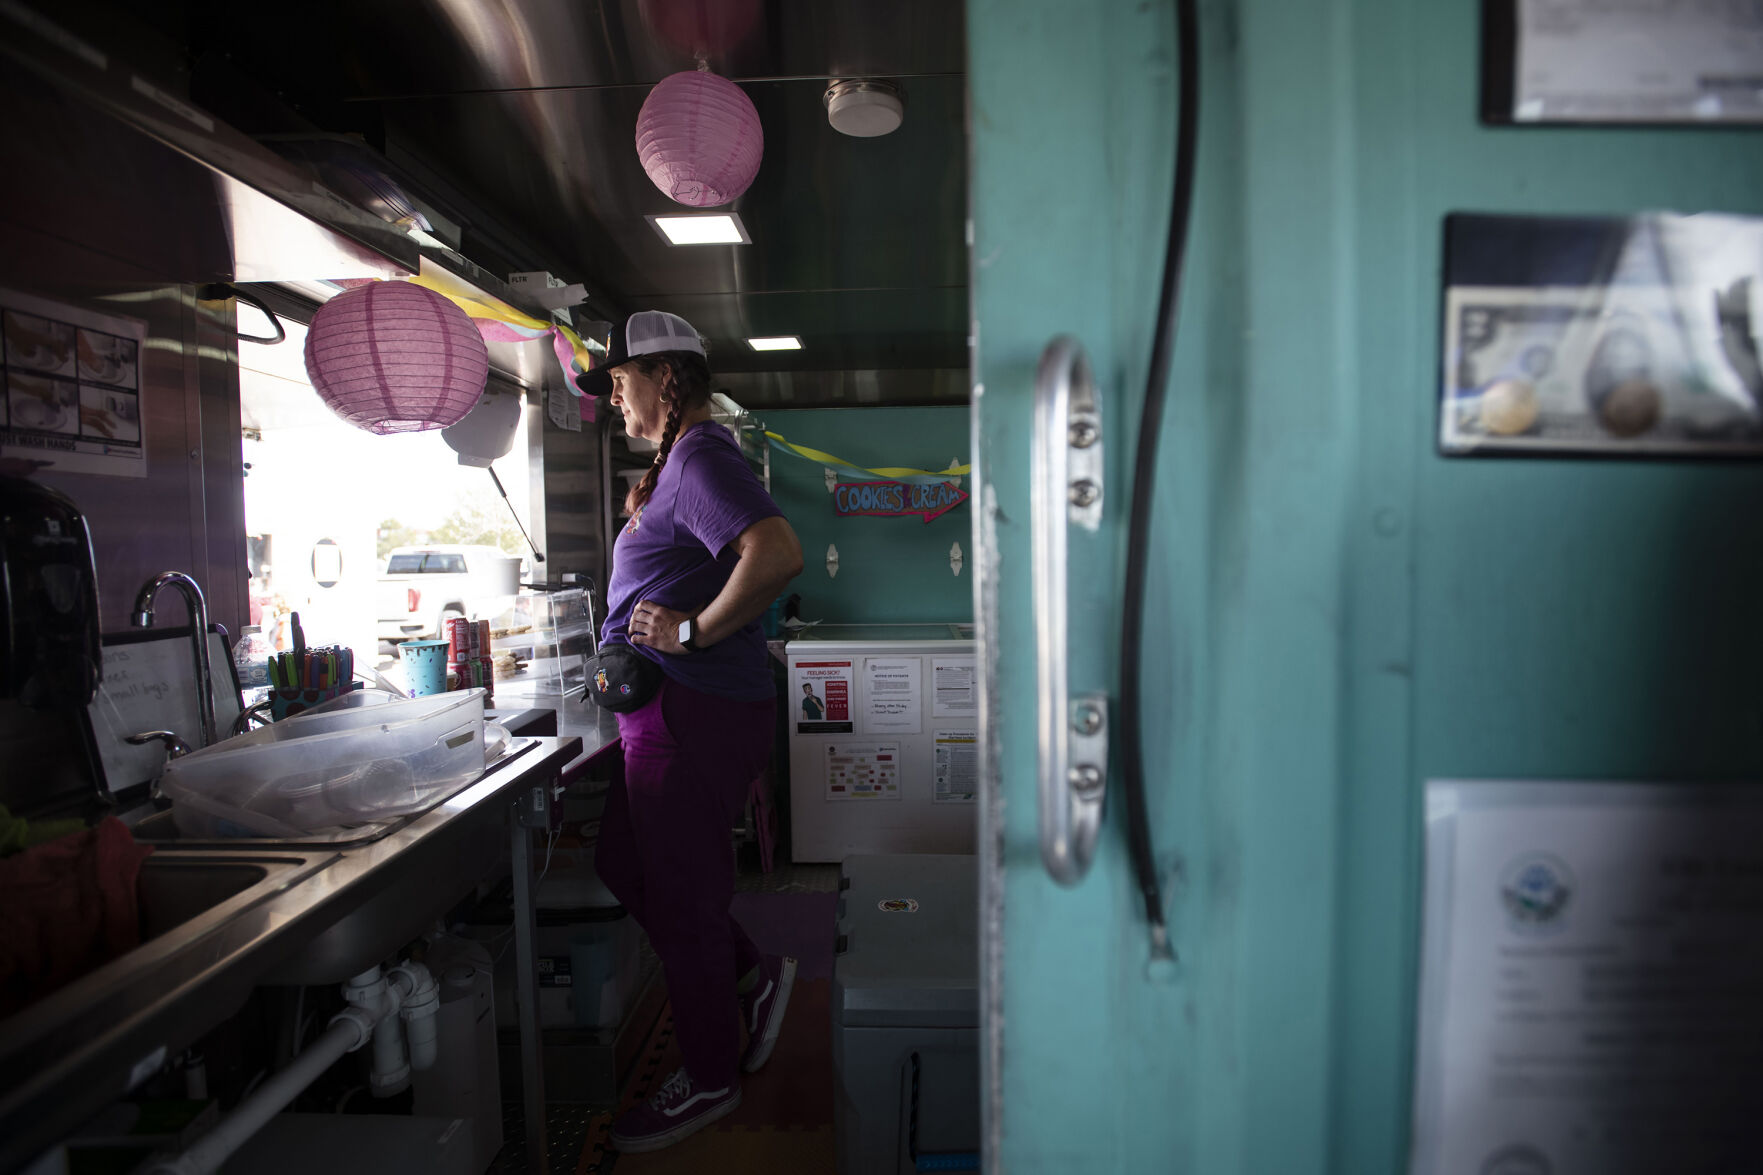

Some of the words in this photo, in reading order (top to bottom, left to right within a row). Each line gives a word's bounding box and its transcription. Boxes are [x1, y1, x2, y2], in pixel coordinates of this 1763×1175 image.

[19, 436, 45, 448] WASH
[48, 438, 76, 451] HANDS
[836, 485, 904, 512] COOKIES
[911, 483, 960, 509] CREAM
